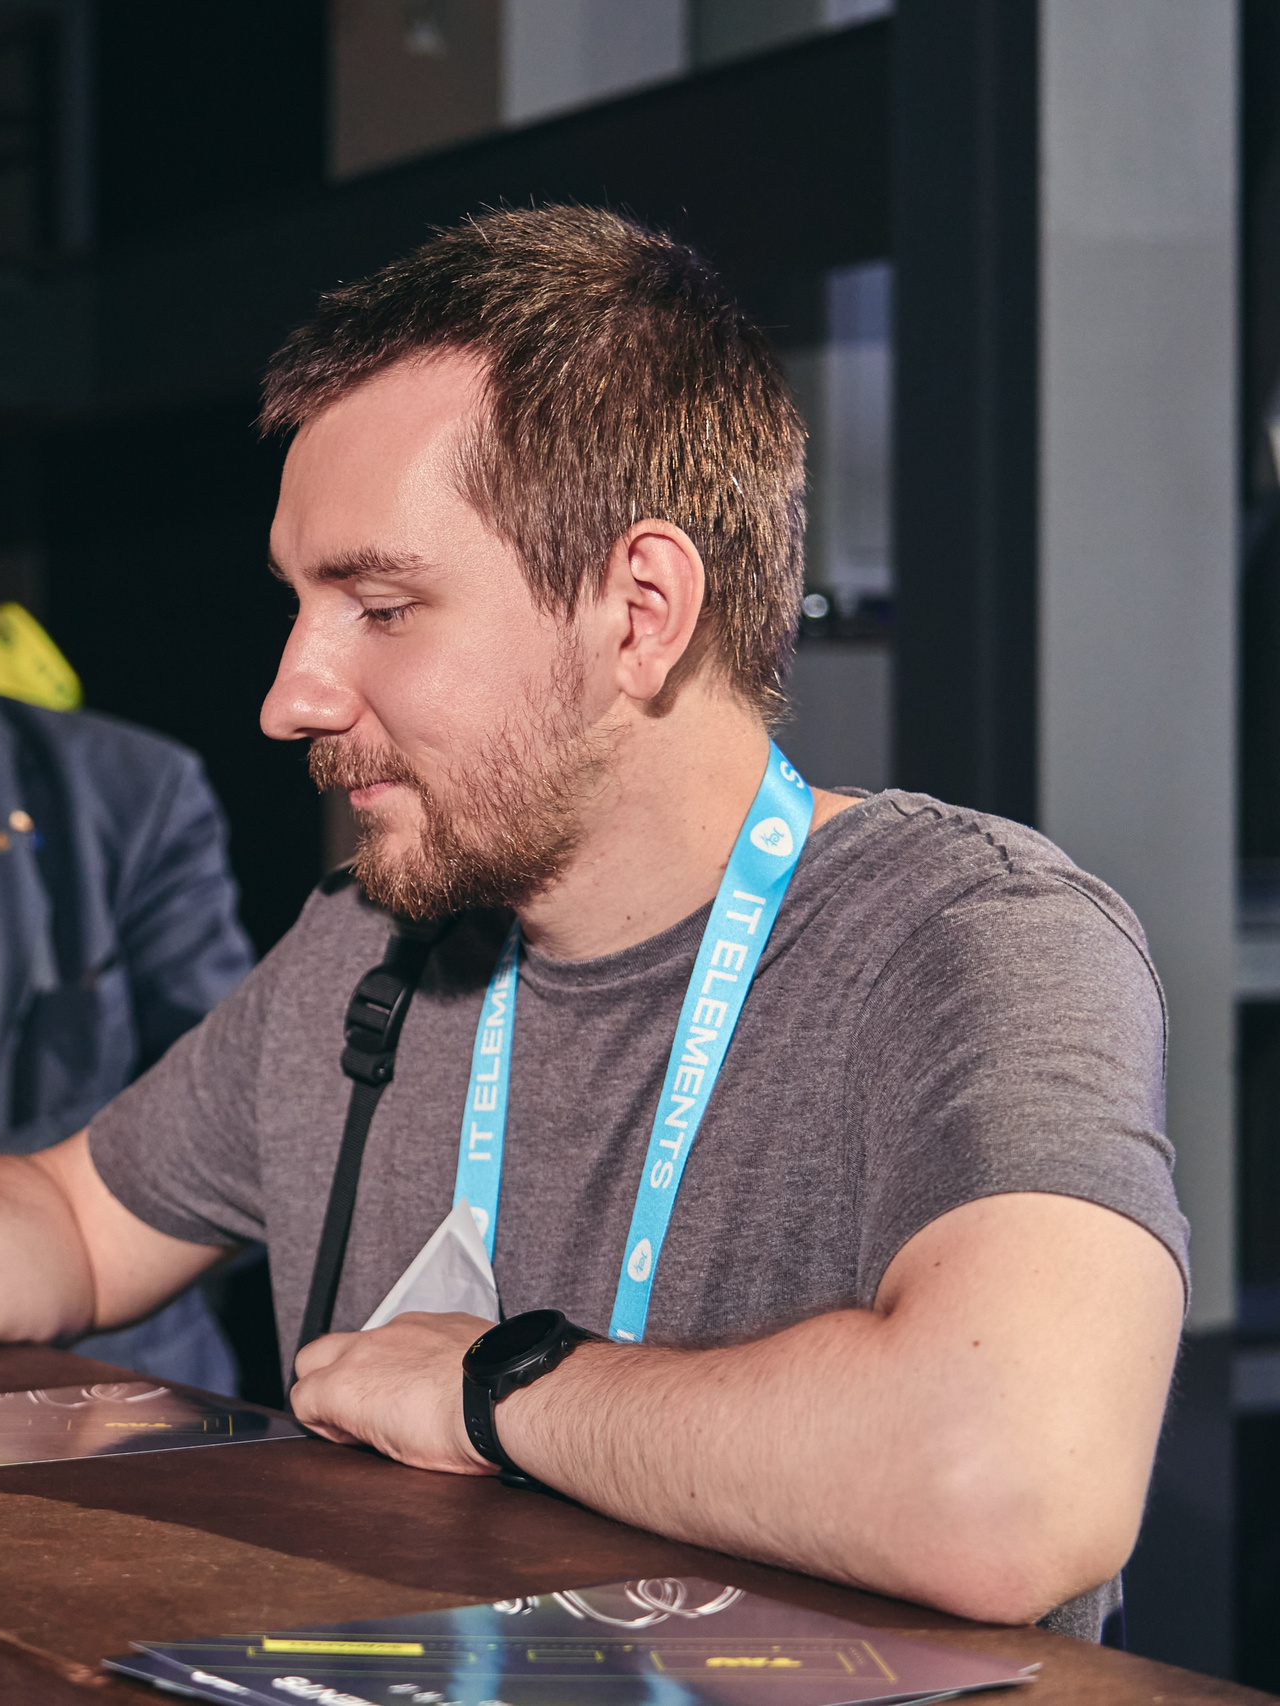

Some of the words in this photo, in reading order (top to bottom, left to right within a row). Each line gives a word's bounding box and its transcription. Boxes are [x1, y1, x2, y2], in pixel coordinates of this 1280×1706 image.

[726, 889, 766, 935] IT
[649, 943, 749, 1189] ELEMENTS
[468, 1121, 493, 1161] IT
